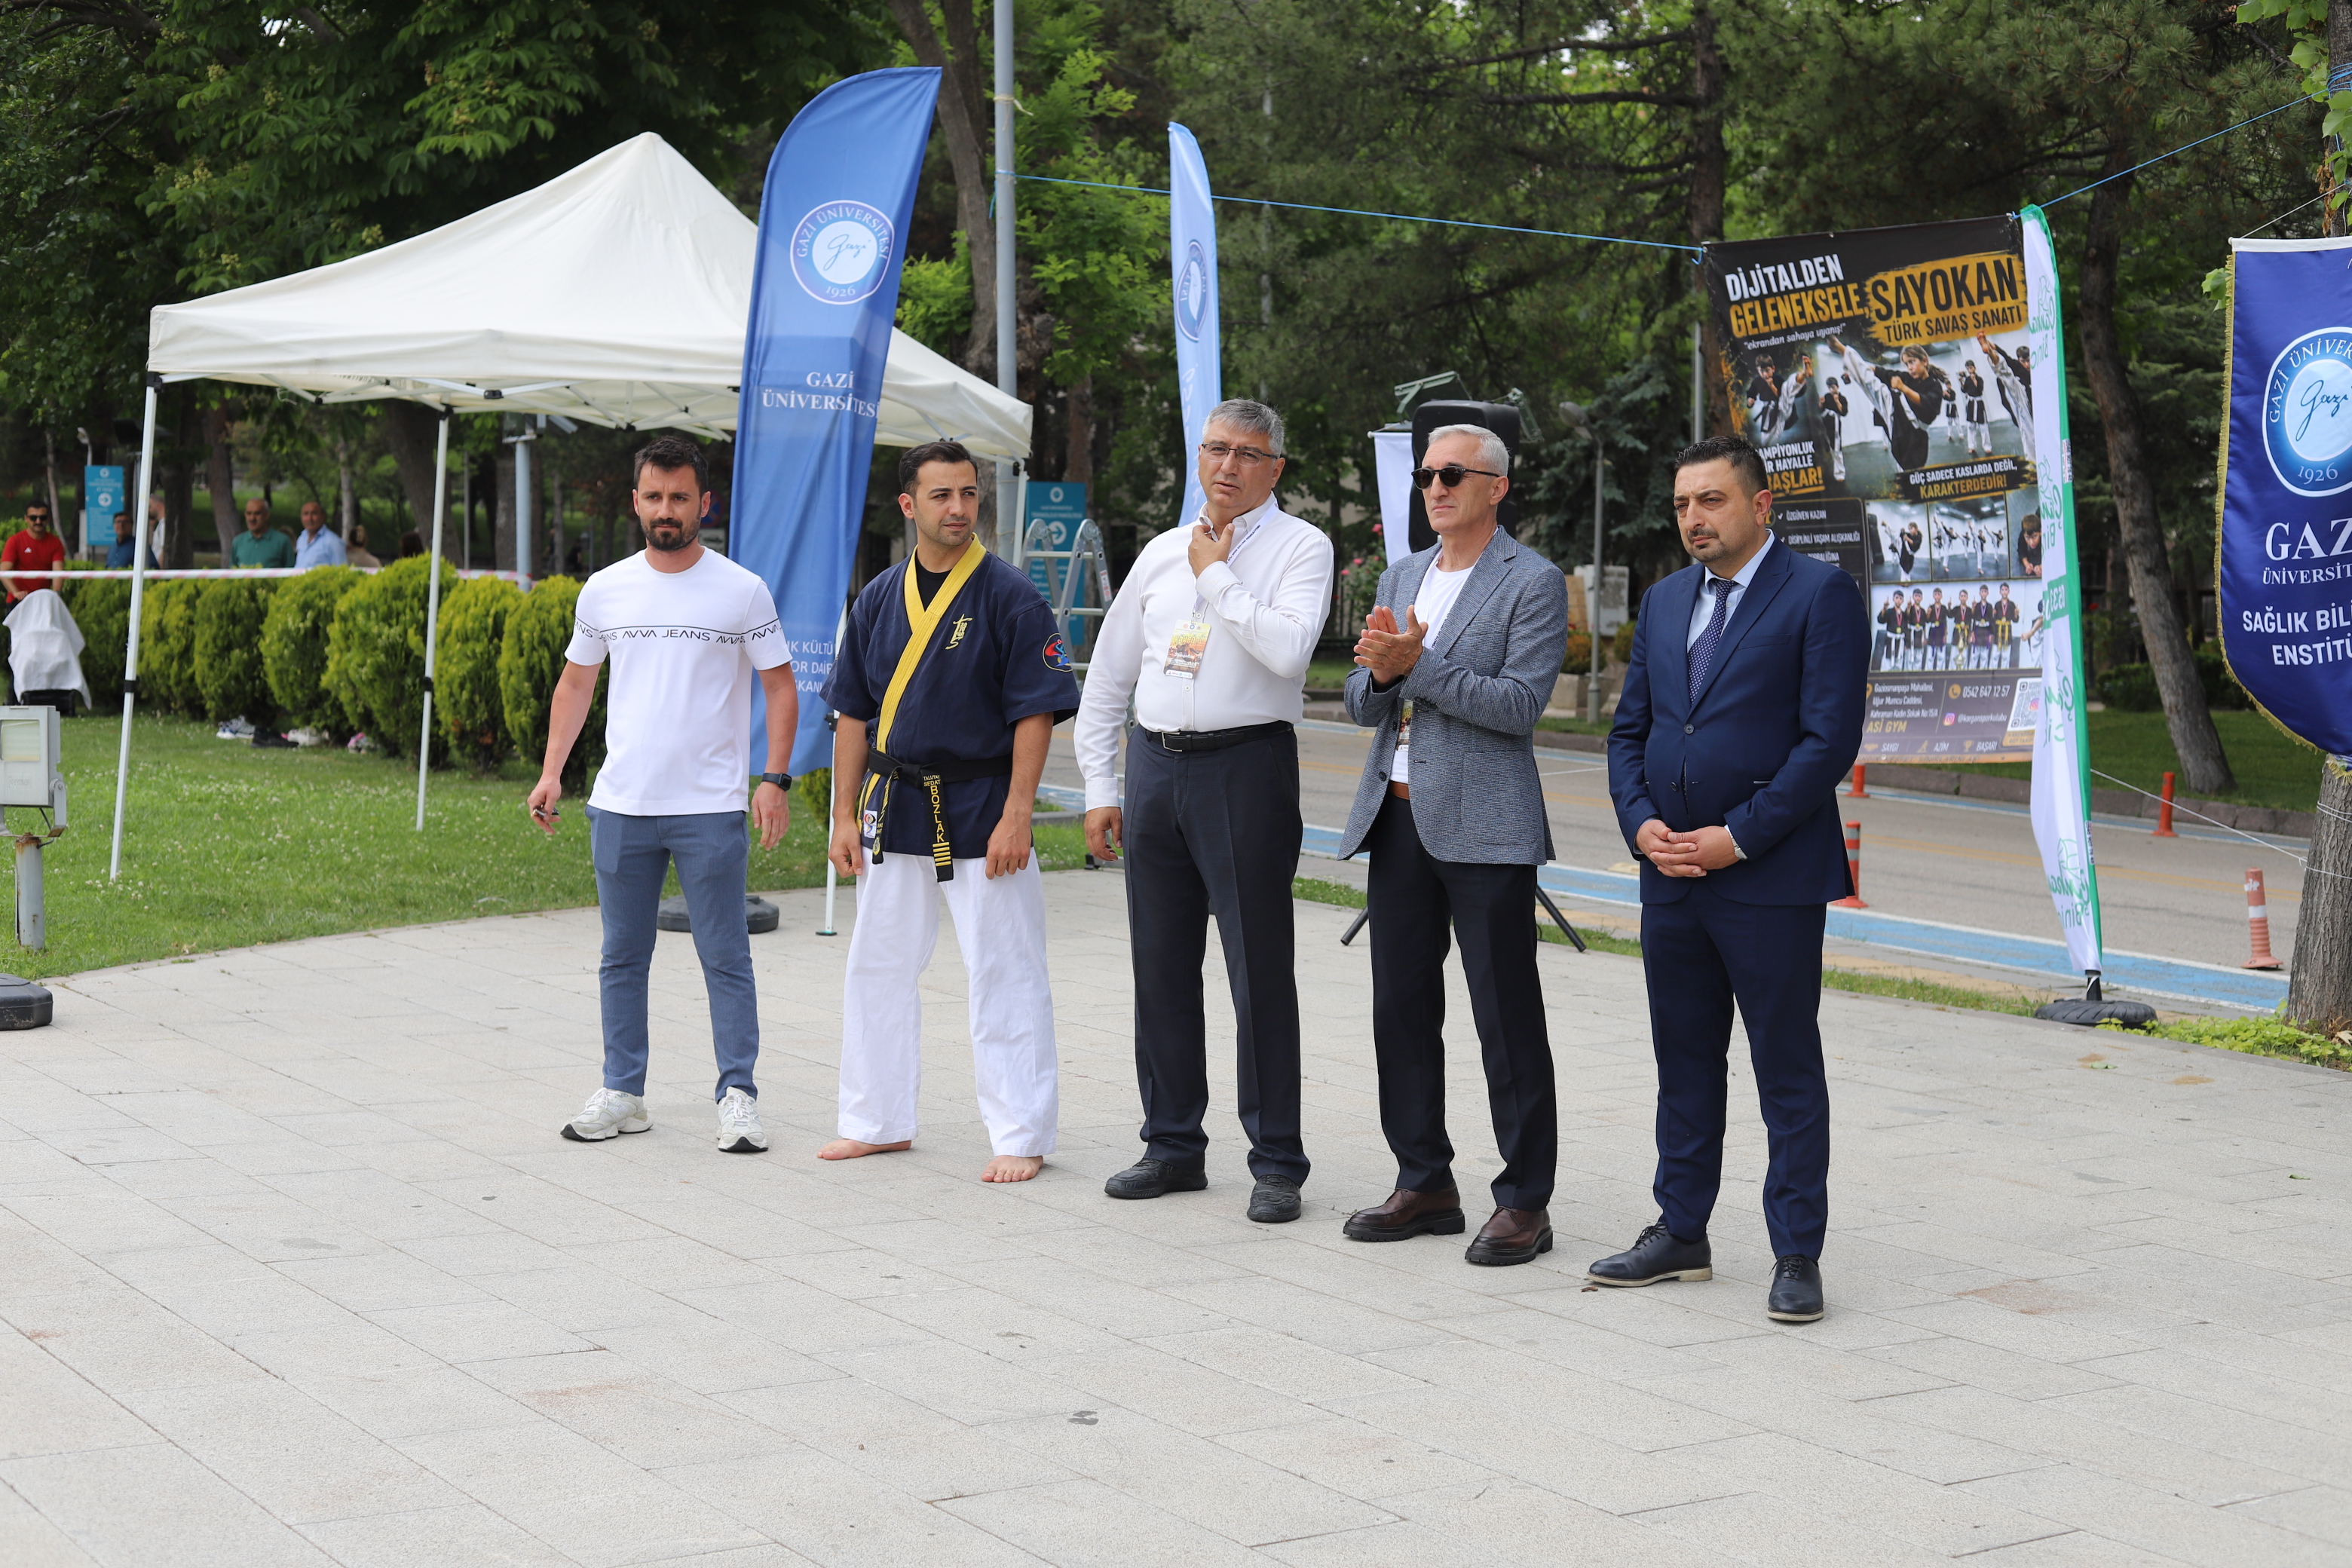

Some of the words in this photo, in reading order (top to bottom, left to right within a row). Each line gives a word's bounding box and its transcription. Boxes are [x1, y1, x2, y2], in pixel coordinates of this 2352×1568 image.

[796, 222, 816, 257] GAZİ
[1725, 253, 1845, 302] DİJİTALDEN
[1871, 257, 2019, 322] SAYOKAN
[825, 285, 856, 298] 1926
[1729, 282, 1870, 338] GELENEKSELE,
[1786, 328, 1815, 344] sahaya
[1884, 320, 1922, 343] TÜRK
[1925, 313, 1969, 335] SAVAŞ
[1972, 305, 2023, 329] SANATI
[806, 371, 855, 388] GAZİ
[762, 388, 880, 418] ÜNİVERSİTESİ
[2269, 369, 2289, 424] GAZİ
[1755, 441, 1815, 459] AMPİYONLUK
[1775, 455, 1814, 472] HAYALLE
[1909, 471, 1925, 485] GÜÇ
[1926, 468, 1954, 482] SADECE
[1955, 462, 1993, 479] KASLARDA
[1993, 458, 2017, 473] DEĞİL,
[2298, 462, 2338, 485] 1926
[1766, 466, 1824, 494] BAŞLAR!
[1919, 473, 2007, 499] KARAKTERDEDİR!
[1786, 510, 1809, 521] ÖZGÜVEN
[1810, 510, 1827, 520] KAZAN
[1813, 533, 1830, 545] YAŞAM
[2265, 517, 2352, 561] GAZ
[2262, 562, 2352, 585] ÜNİVERSİT
[2243, 605, 2309, 633] SAĞLIK
[662, 629, 711, 642] JEANS
[1962, 685, 1979, 698] 0542
[1979, 685, 1992, 698] 647
[1993, 685, 2001, 697] 12
[2001, 684, 2011, 698] 57
[1885, 720, 1908, 733] GYM
[1881, 743, 1900, 752] SAYGI
[1934, 741, 1949, 752] AZİM
[1976, 741, 1998, 752] BAŞARI
[929, 786, 945, 843] BOZLAK
